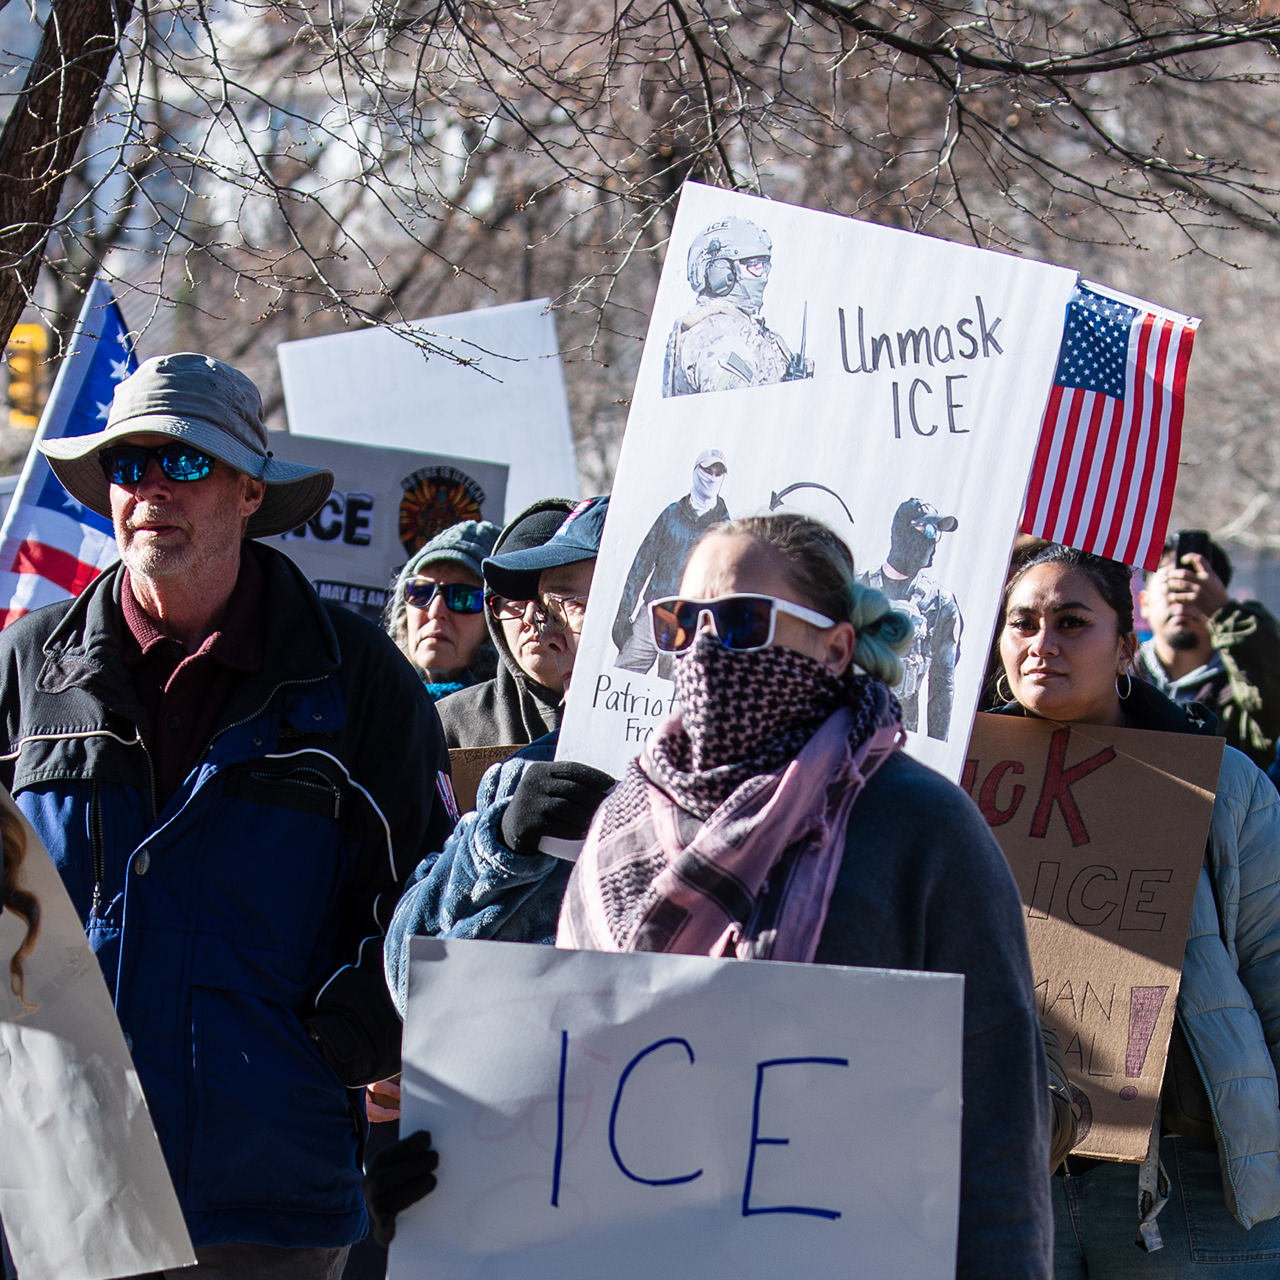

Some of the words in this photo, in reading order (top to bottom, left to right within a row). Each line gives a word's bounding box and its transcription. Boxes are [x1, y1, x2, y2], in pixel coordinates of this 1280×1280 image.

[706, 220, 730, 233] ICE
[839, 295, 1004, 374] Unmask
[891, 374, 971, 440] ICE
[284, 495, 374, 546] CE
[319, 582, 348, 601] MAY
[348, 586, 366, 605] BE
[1027, 861, 1174, 932] ICE
[550, 1030, 850, 1221] ICE
